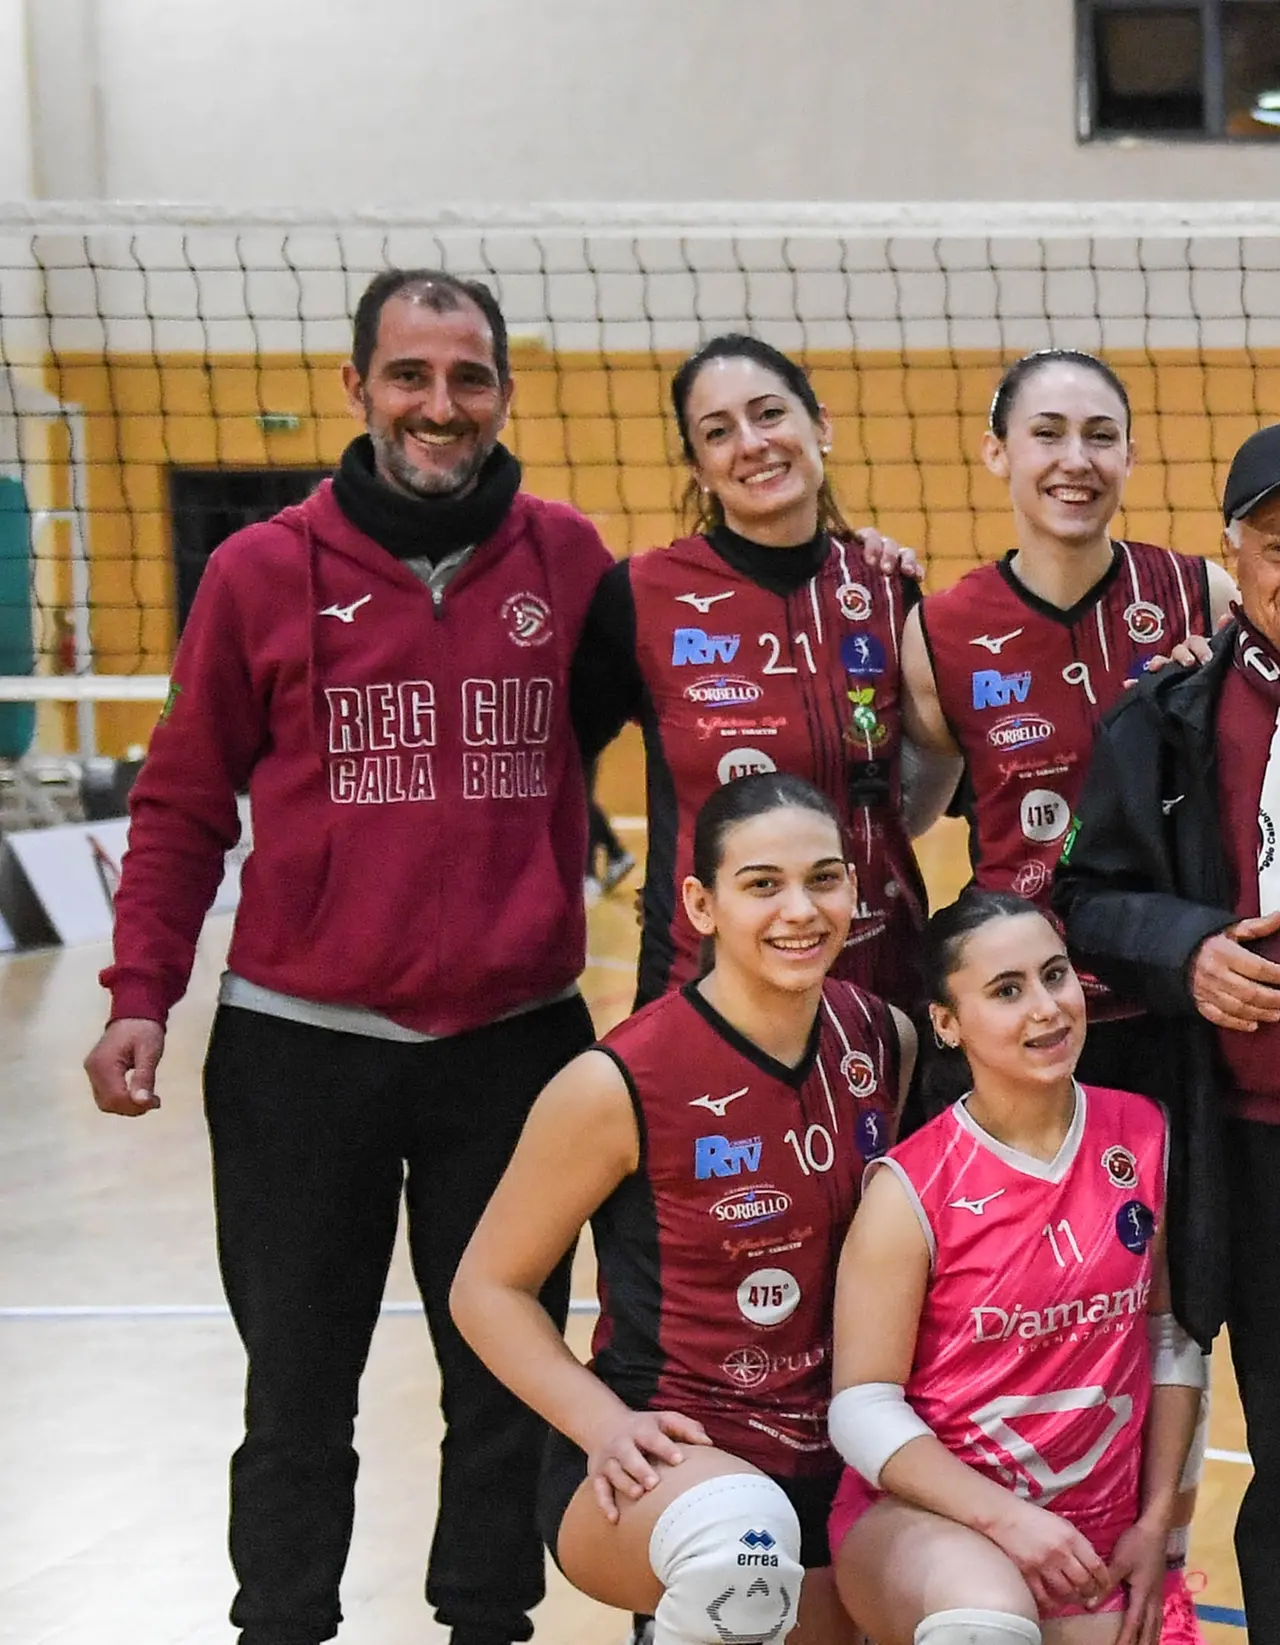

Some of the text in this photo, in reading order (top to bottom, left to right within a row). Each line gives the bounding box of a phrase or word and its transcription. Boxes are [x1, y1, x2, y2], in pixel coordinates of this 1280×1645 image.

[758, 632, 817, 675] 21
[688, 685, 760, 703] SORBELLO
[1061, 662, 1097, 704] 9
[325, 678, 554, 753] REG GIO
[990, 723, 1051, 746] SORBELLO
[329, 751, 548, 805] CALA BRIA
[783, 1123, 835, 1176] 10
[715, 1195, 788, 1222] SORBELLO
[1042, 1219, 1084, 1268] 11
[748, 1282, 790, 1308] 475°
[737, 1552, 779, 1568] errea
